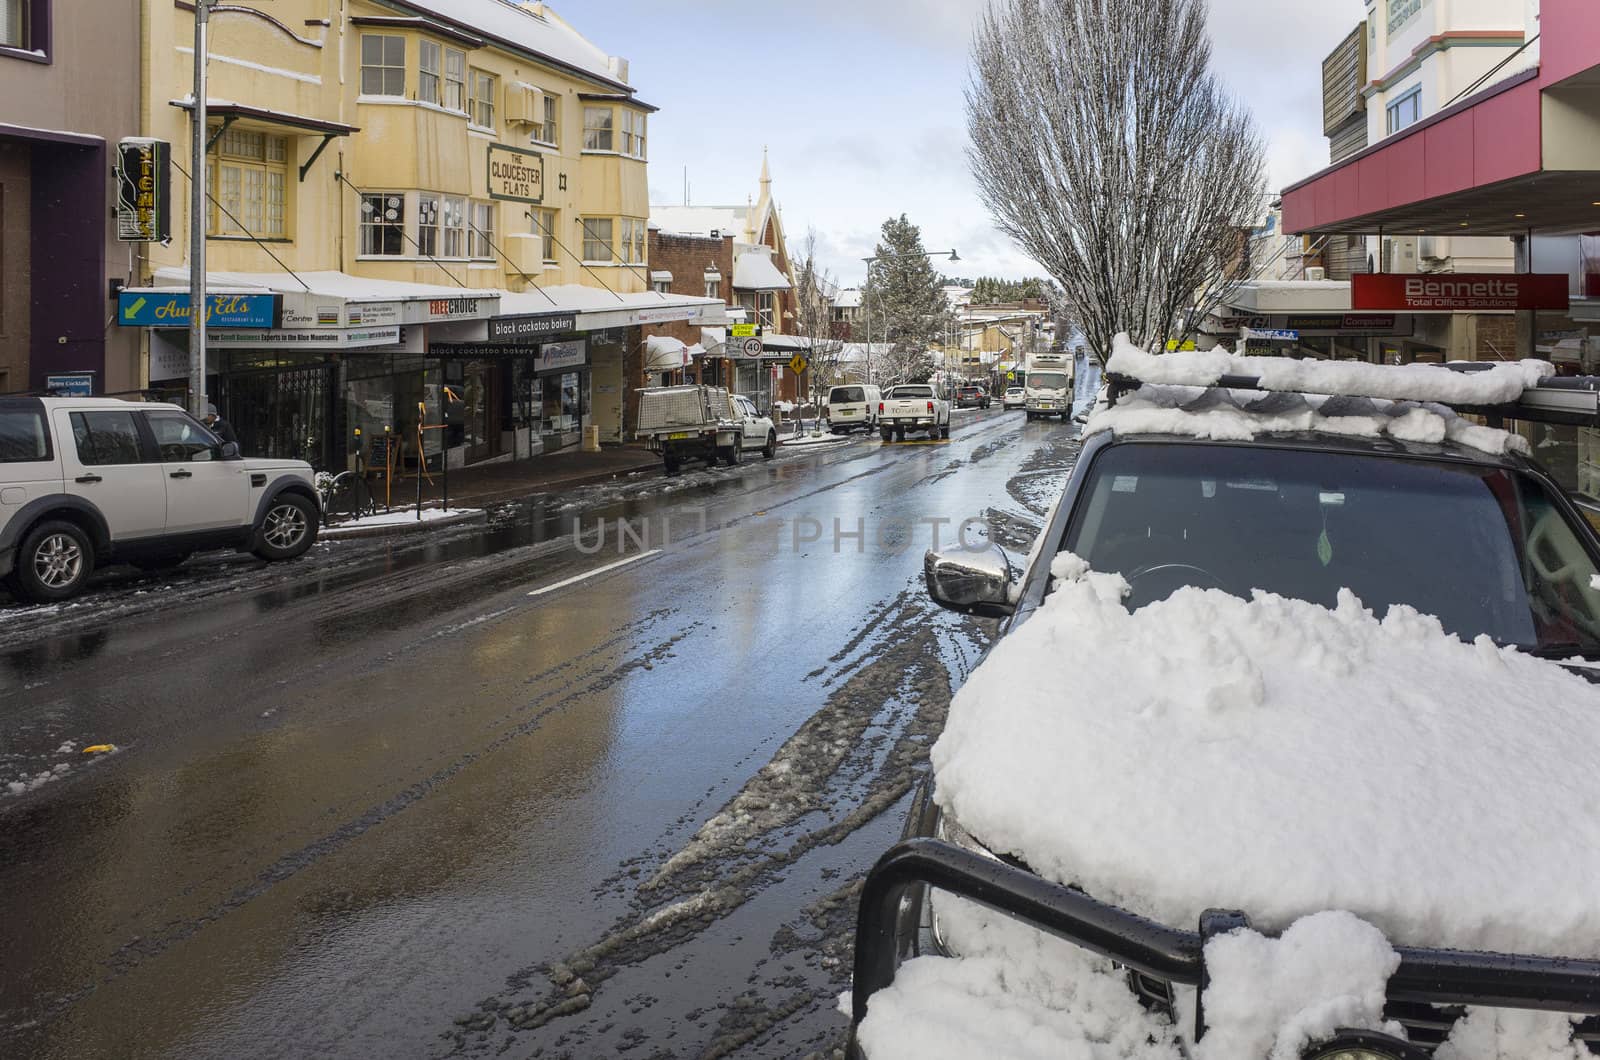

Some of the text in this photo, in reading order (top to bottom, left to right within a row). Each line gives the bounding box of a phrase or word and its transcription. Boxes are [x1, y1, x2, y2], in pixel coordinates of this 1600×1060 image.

[512, 154, 523, 164] THE
[503, 181, 530, 197] FLATS
[1405, 279, 1519, 297] Bennetts
[1406, 298, 1519, 308] Total Office Solutions
[155, 297, 250, 322] Auy Ed's
[495, 318, 573, 335] black cockatoo bakery
[1344, 317, 1393, 327] Computers
[261, 334, 281, 342] Experts
[457, 346, 500, 355] cockatoo
[503, 346, 534, 356] bakery
[747, 342, 760, 352] 40
